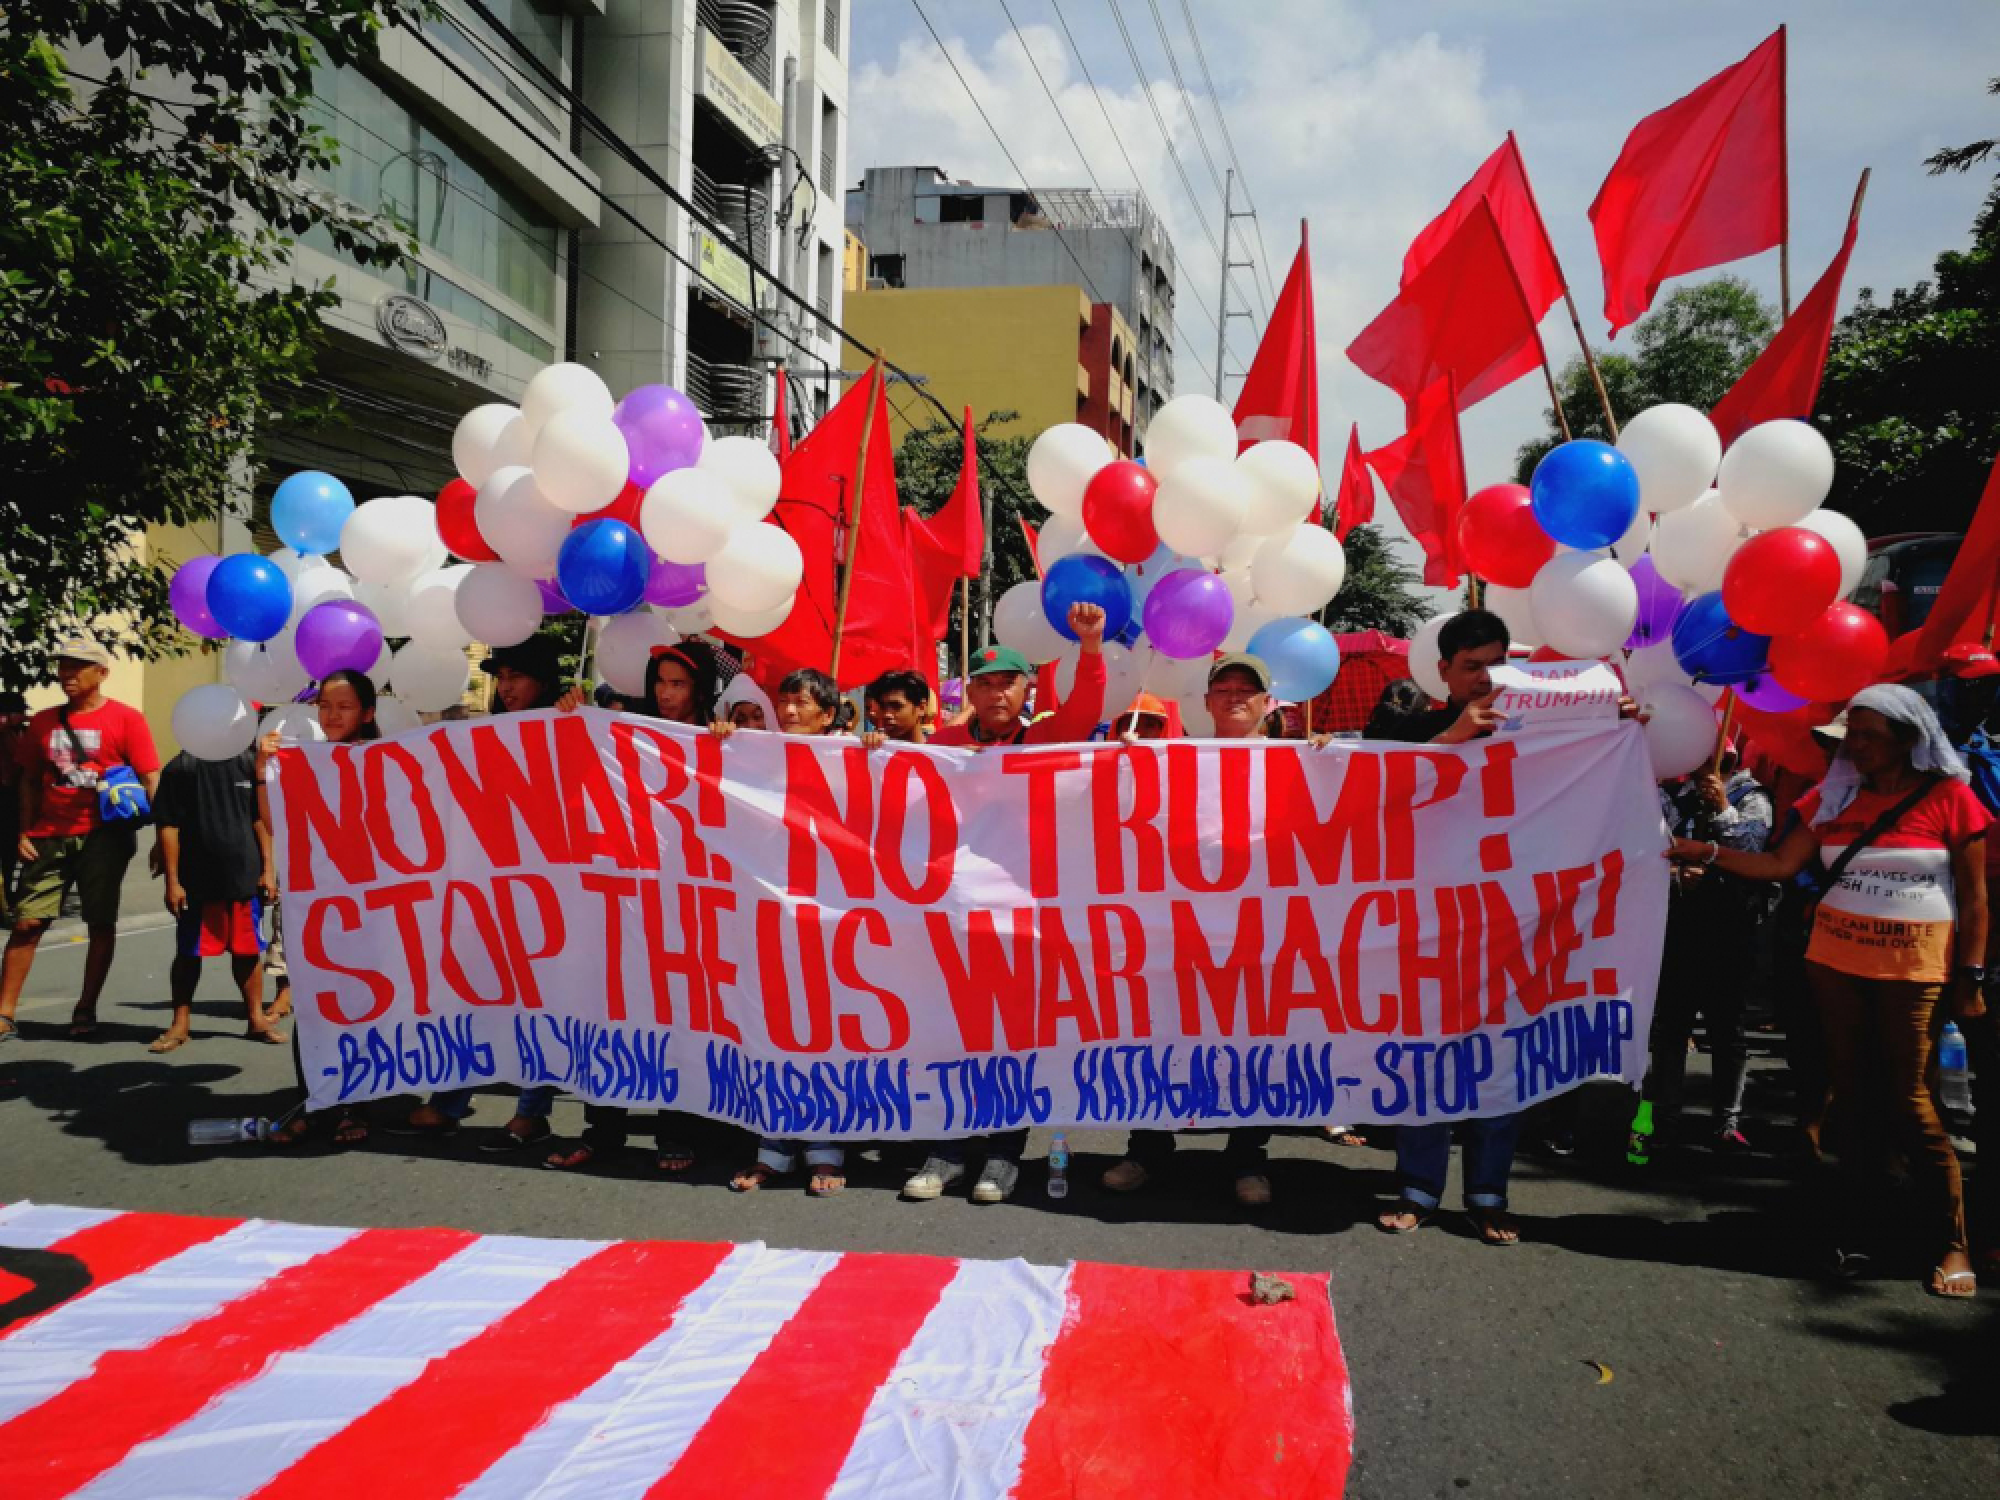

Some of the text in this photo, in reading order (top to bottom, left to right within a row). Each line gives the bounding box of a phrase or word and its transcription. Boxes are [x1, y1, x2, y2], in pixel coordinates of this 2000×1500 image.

[1503, 688, 1615, 711] TRUMP!!!
[1531, 668, 1579, 680] BAN
[277, 715, 1518, 904] NO WAR! NO TRUMP!
[303, 849, 1625, 1053] STOP THE US WAR MACHINE!
[1501, 999, 1634, 1103] TRUMP
